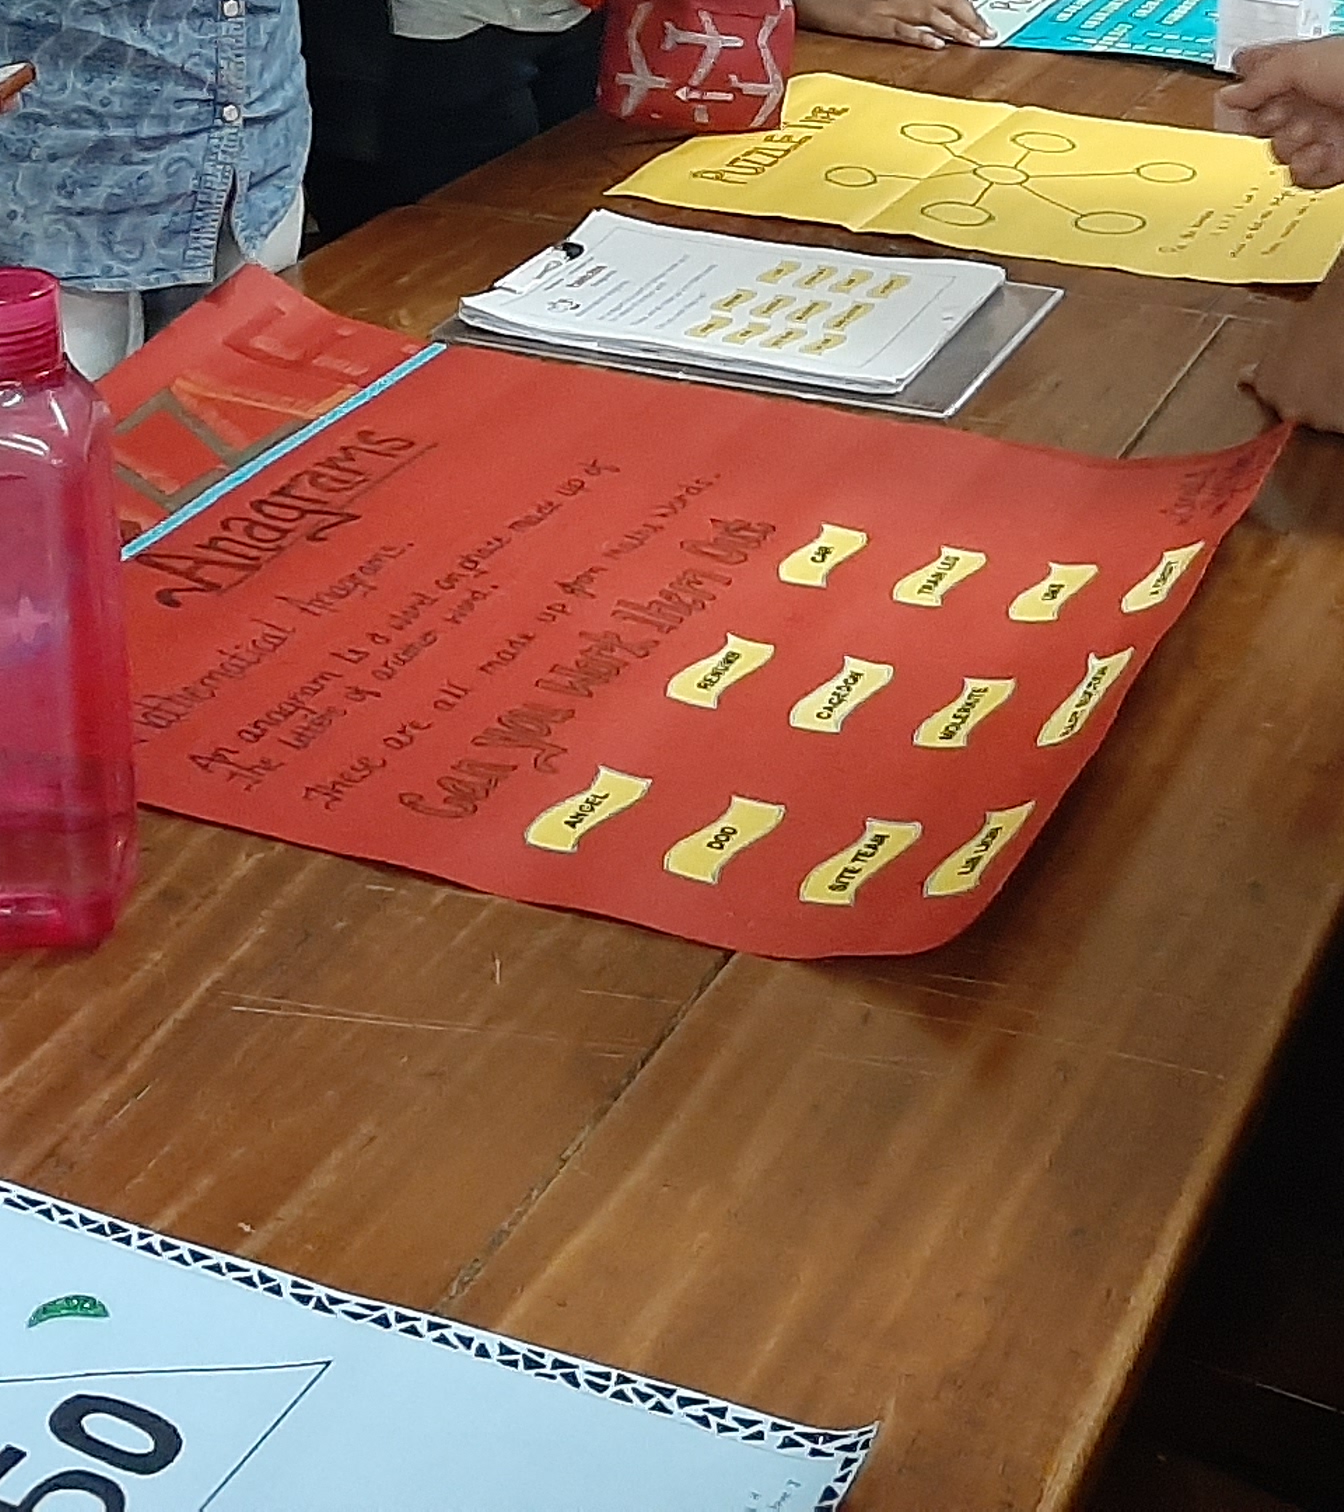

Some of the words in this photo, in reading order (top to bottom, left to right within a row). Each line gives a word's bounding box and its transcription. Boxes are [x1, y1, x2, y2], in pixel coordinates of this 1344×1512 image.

[136, 430, 416, 608] Anagrams
[134, 619, 296, 741] athematical
[382, 718, 435, 750] are
[432, 678, 471, 710] all
[563, 791, 611, 830] ANGEL
[706, 825, 738, 850] DOD
[827, 866, 863, 893] SITE
[851, 834, 891, 865] TEAM
